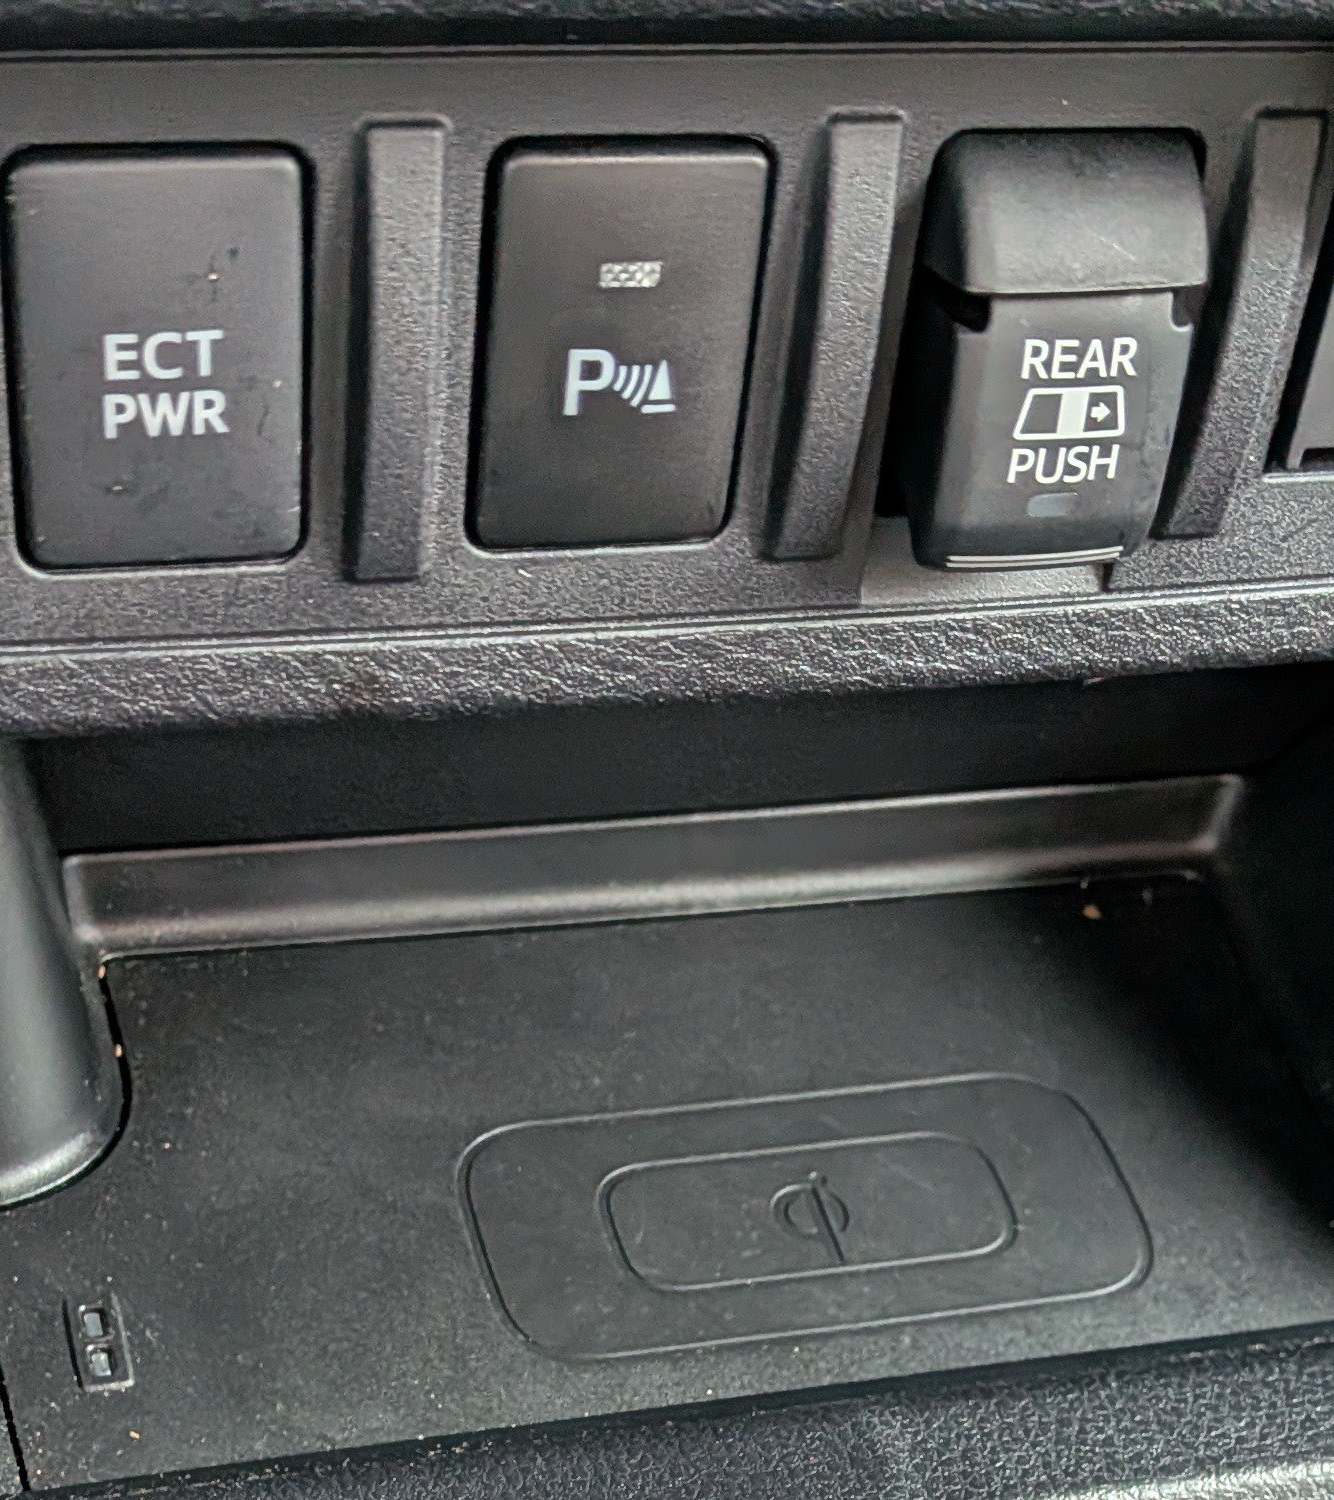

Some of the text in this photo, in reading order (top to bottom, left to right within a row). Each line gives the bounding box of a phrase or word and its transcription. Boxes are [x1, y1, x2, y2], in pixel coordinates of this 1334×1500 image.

[103, 329, 225, 381] ECT
[1021, 335, 1139, 380] REAR
[561, 347, 615, 416] P
[102, 389, 231, 440] PWR
[1006, 444, 1121, 485] PUSH
